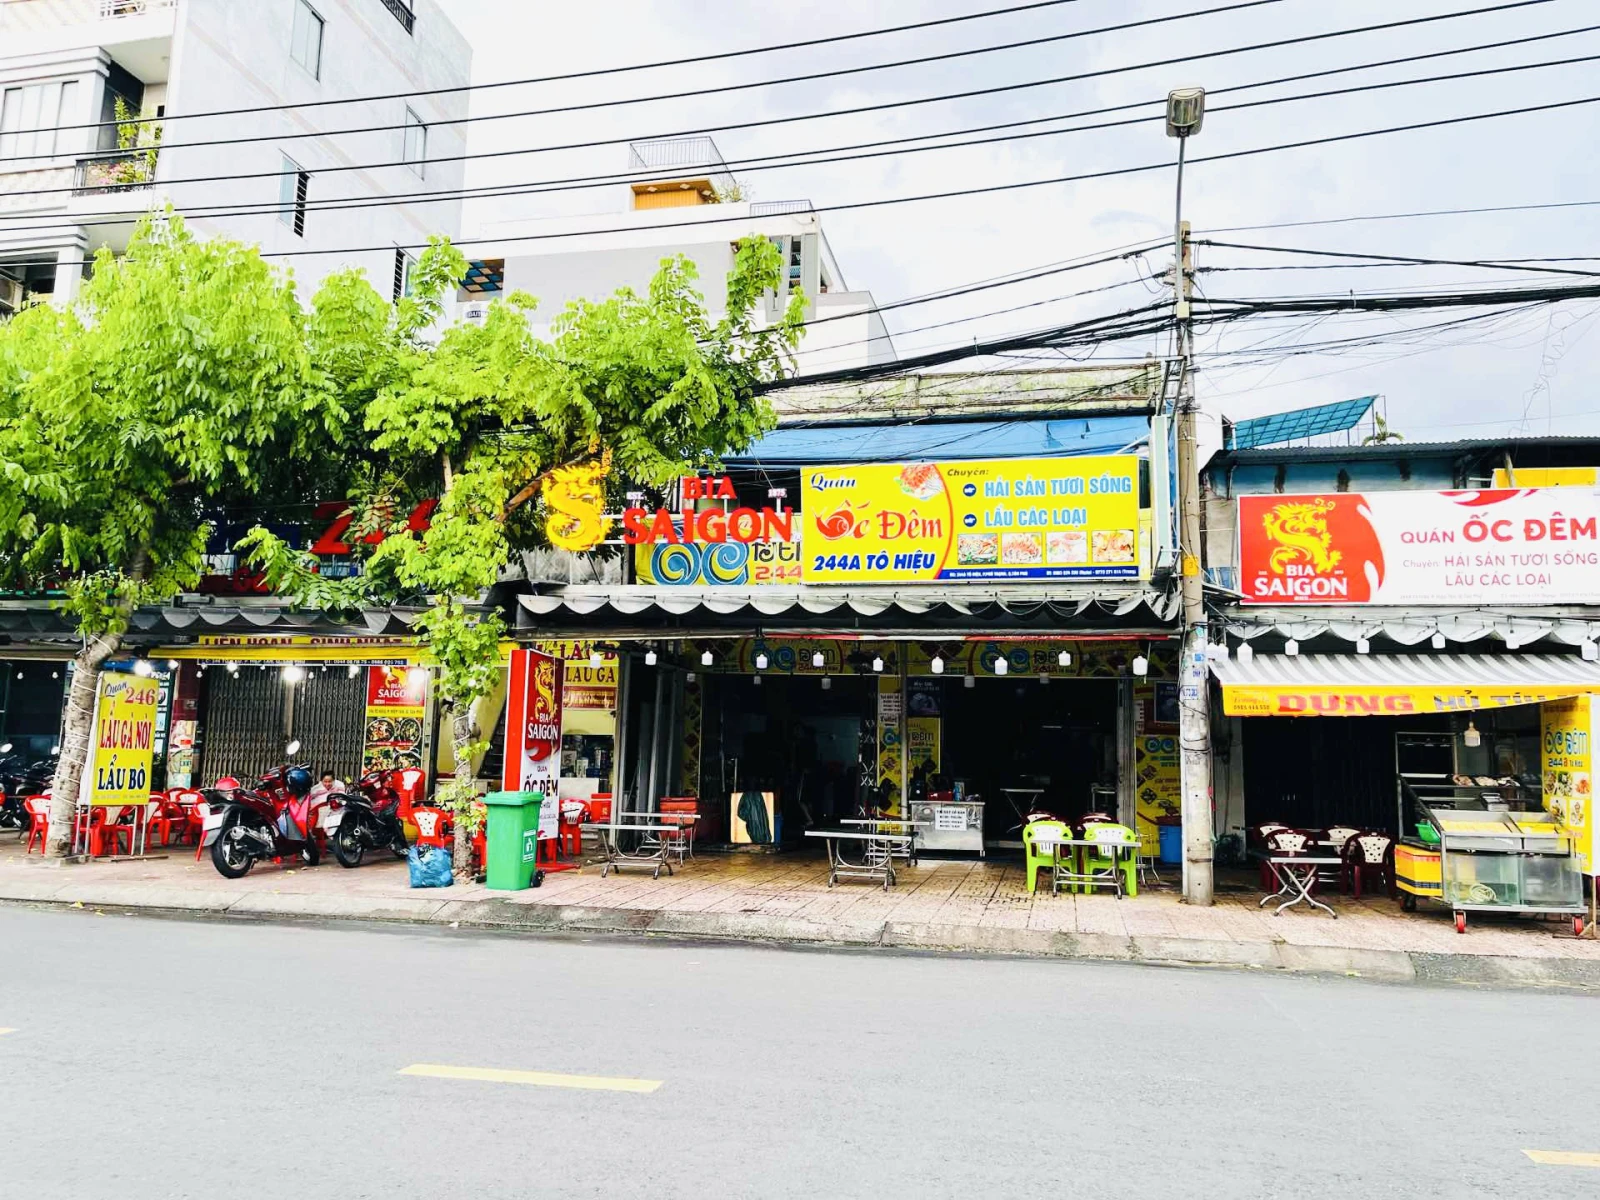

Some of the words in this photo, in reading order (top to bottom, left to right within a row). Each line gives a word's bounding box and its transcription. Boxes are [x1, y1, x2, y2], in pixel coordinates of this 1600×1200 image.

[683, 475, 737, 499] BIA
[984, 475, 1010, 497] HẢI
[1014, 474, 1046, 496] SẢN
[1050, 477, 1084, 495] TƯƠI
[1089, 471, 1132, 494] SỐNG
[623, 506, 794, 544] SAIGON
[876, 509, 943, 540] Đêm
[985, 503, 1013, 526] LẨU
[1018, 506, 1048, 525] CÁC
[1053, 508, 1087, 528] LOẠI
[1400, 527, 1455, 544] QUÁN
[1462, 512, 1514, 542] ỐC
[1523, 511, 1597, 542] ĐÊM
[814, 555, 861, 571] 244A
[866, 550, 889, 569] TÔ
[893, 550, 936, 574] HIỆU
[1286, 564, 1316, 576] BIA
[1510, 553, 1549, 566] TƯƠI
[1254, 578, 1348, 596] SAIGON
[1479, 570, 1511, 586] CÁC
[1516, 573, 1552, 589] LOẠI
[125, 687, 155, 705] 246
[528, 723, 558, 739] SAIGON
[98, 754, 126, 790] LẨU
[128, 762, 146, 790] BÒ
